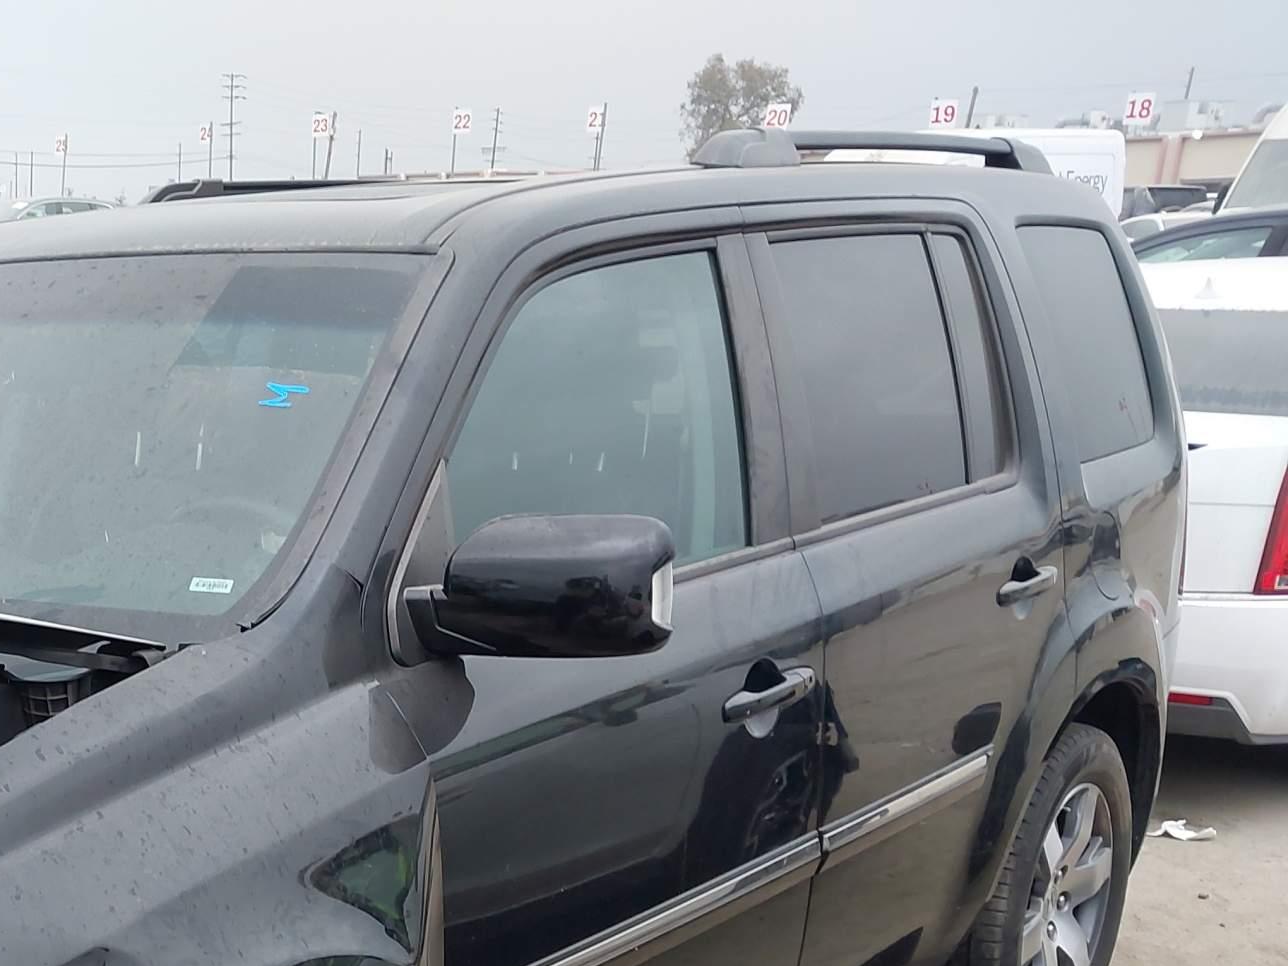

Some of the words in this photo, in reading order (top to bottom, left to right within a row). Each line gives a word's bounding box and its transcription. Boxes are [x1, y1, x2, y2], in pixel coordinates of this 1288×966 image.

[930, 104, 956, 124] 19
[1125, 98, 1153, 119] 18
[312, 118, 329, 133] 23
[453, 113, 472, 130] 22
[765, 109, 789, 127] 20
